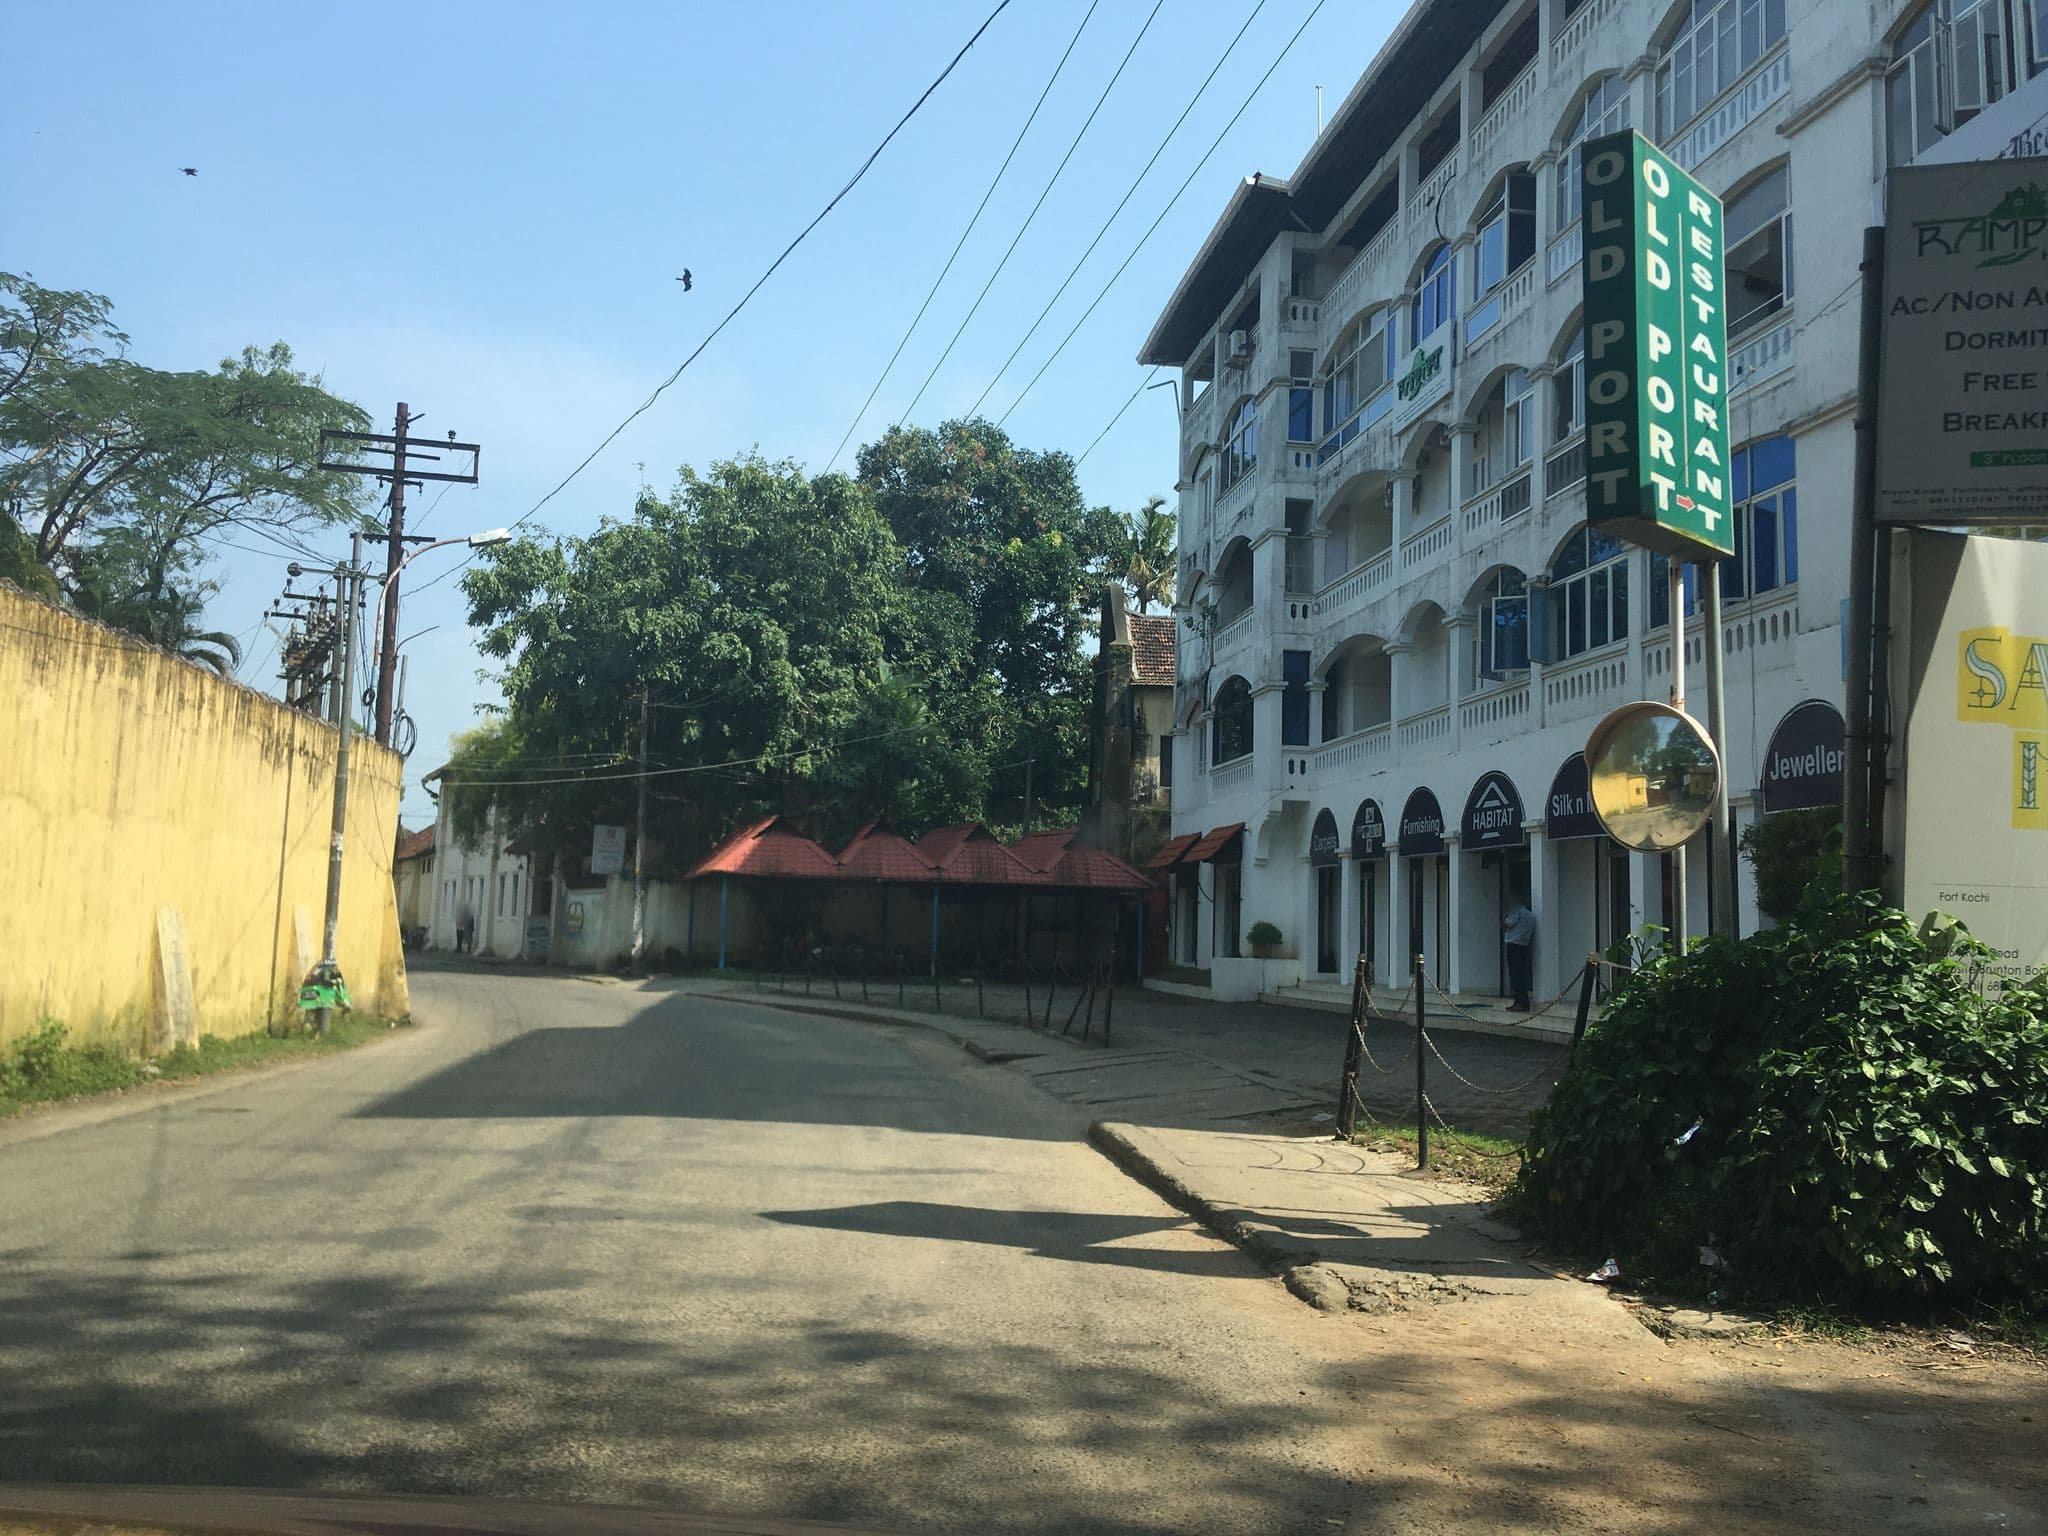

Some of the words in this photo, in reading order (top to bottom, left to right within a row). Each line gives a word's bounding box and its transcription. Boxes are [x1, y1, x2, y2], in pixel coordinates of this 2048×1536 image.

[1585, 151, 1625, 283] OLD
[1642, 158, 1672, 291] OLD
[2023, 286, 2048, 307] A
[1687, 189, 1722, 532] RESTAURANT
[1588, 320, 1630, 505] PORT
[1648, 323, 1677, 511] PORT
[1769, 744, 1846, 781] Jeweller
[1472, 807, 1515, 831] HABITAT
[1552, 793, 1574, 817] Silk
[1576, 797, 1584, 814] n
[1403, 816, 1441, 837] Furnishing
[1939, 891, 1959, 902] Fort
[1961, 892, 1990, 903] Kochi
[1979, 965, 2022, 977] Brunton
